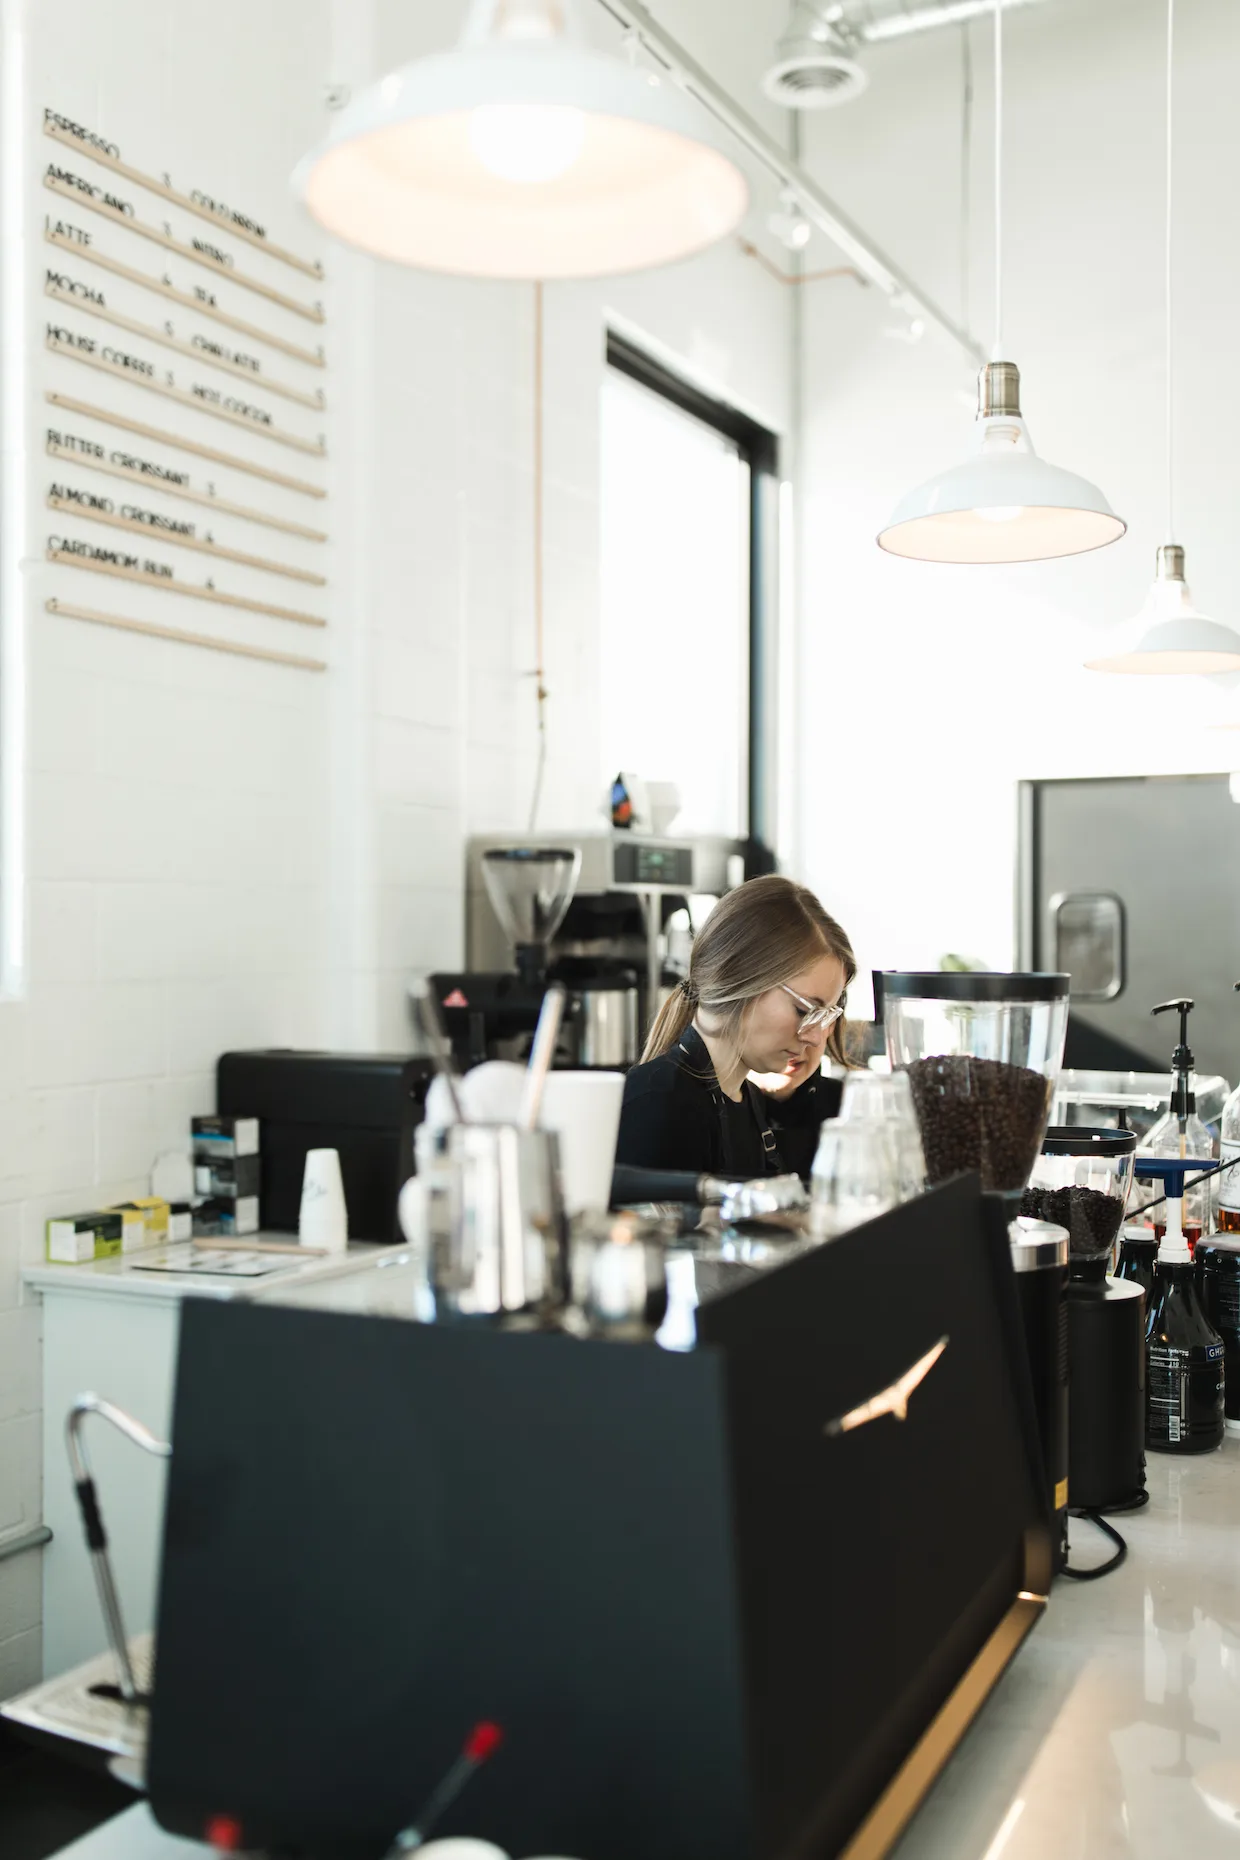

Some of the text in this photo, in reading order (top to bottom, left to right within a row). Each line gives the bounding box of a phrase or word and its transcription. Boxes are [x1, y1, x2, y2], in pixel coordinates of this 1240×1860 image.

[44, 108, 120, 160] ESPRESSO
[47, 164, 135, 219] AMERICANO
[45, 214, 92, 246] LATTE
[46, 269, 105, 307] MOCHA
[46, 322, 96, 353] HOUSE
[47, 429, 190, 487] BUTTER CROISSANT
[50, 482, 195, 537] ALMOND CROISSANT
[48, 535, 138, 569] CARDAMOM
